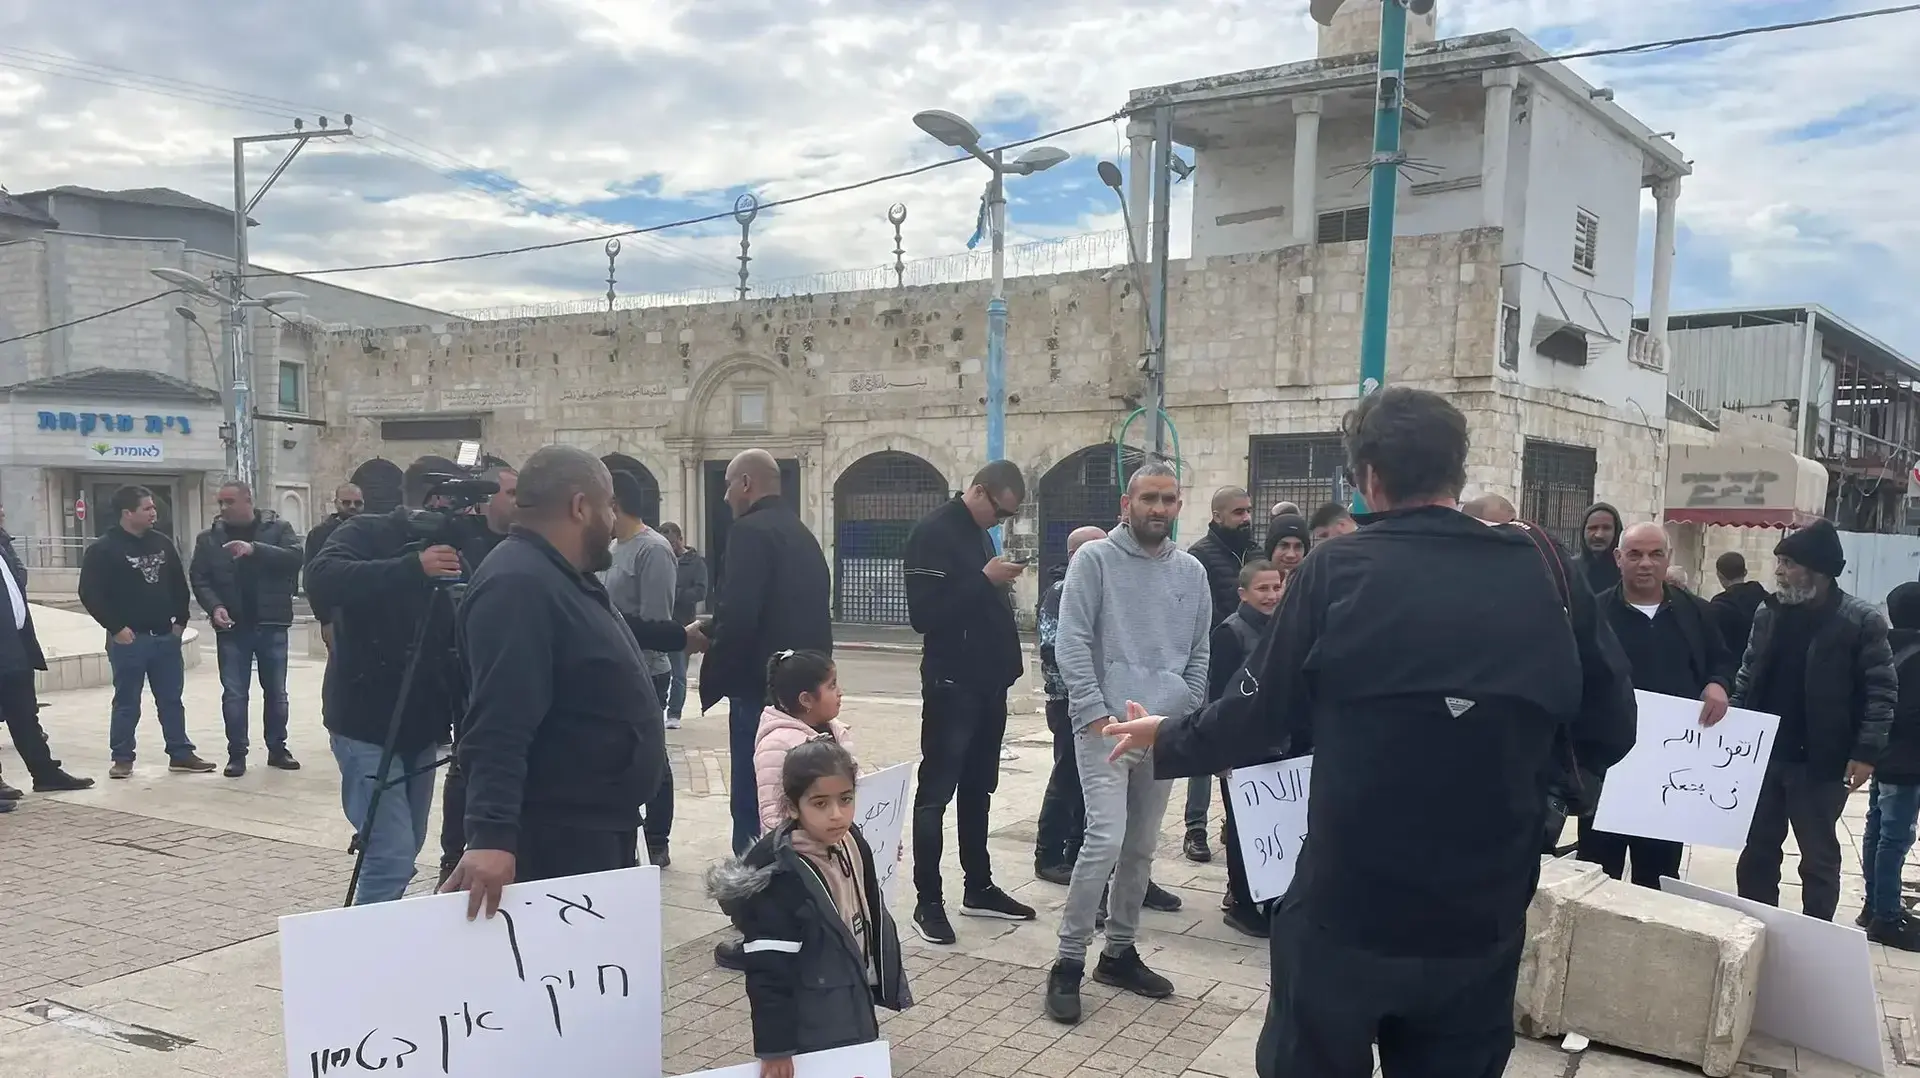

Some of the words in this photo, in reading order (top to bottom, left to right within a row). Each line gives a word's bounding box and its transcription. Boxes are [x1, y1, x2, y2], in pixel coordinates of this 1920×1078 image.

[37, 411, 133, 436] מרקחת
[113, 444, 160, 457] לאומית
[1711, 730, 1764, 768] اتقوا
[1239, 767, 1311, 806] ושה
[438, 1001, 504, 1074] אין
